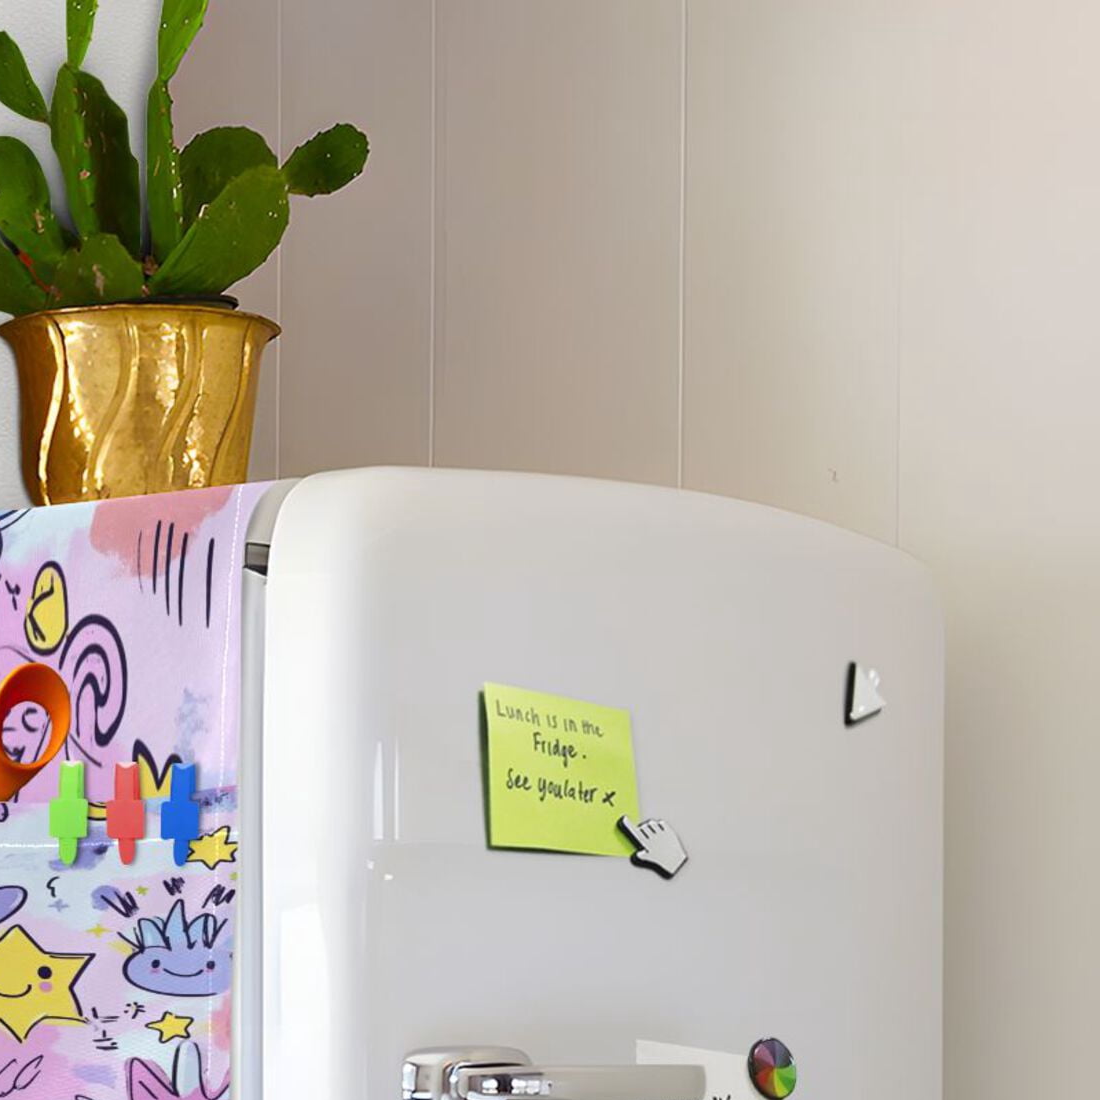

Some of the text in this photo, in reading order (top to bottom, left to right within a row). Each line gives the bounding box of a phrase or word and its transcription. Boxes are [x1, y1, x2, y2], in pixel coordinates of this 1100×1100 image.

[495, 698, 541, 728] Lunch
[582, 719, 605, 739] the
[506, 767, 532, 791] See
